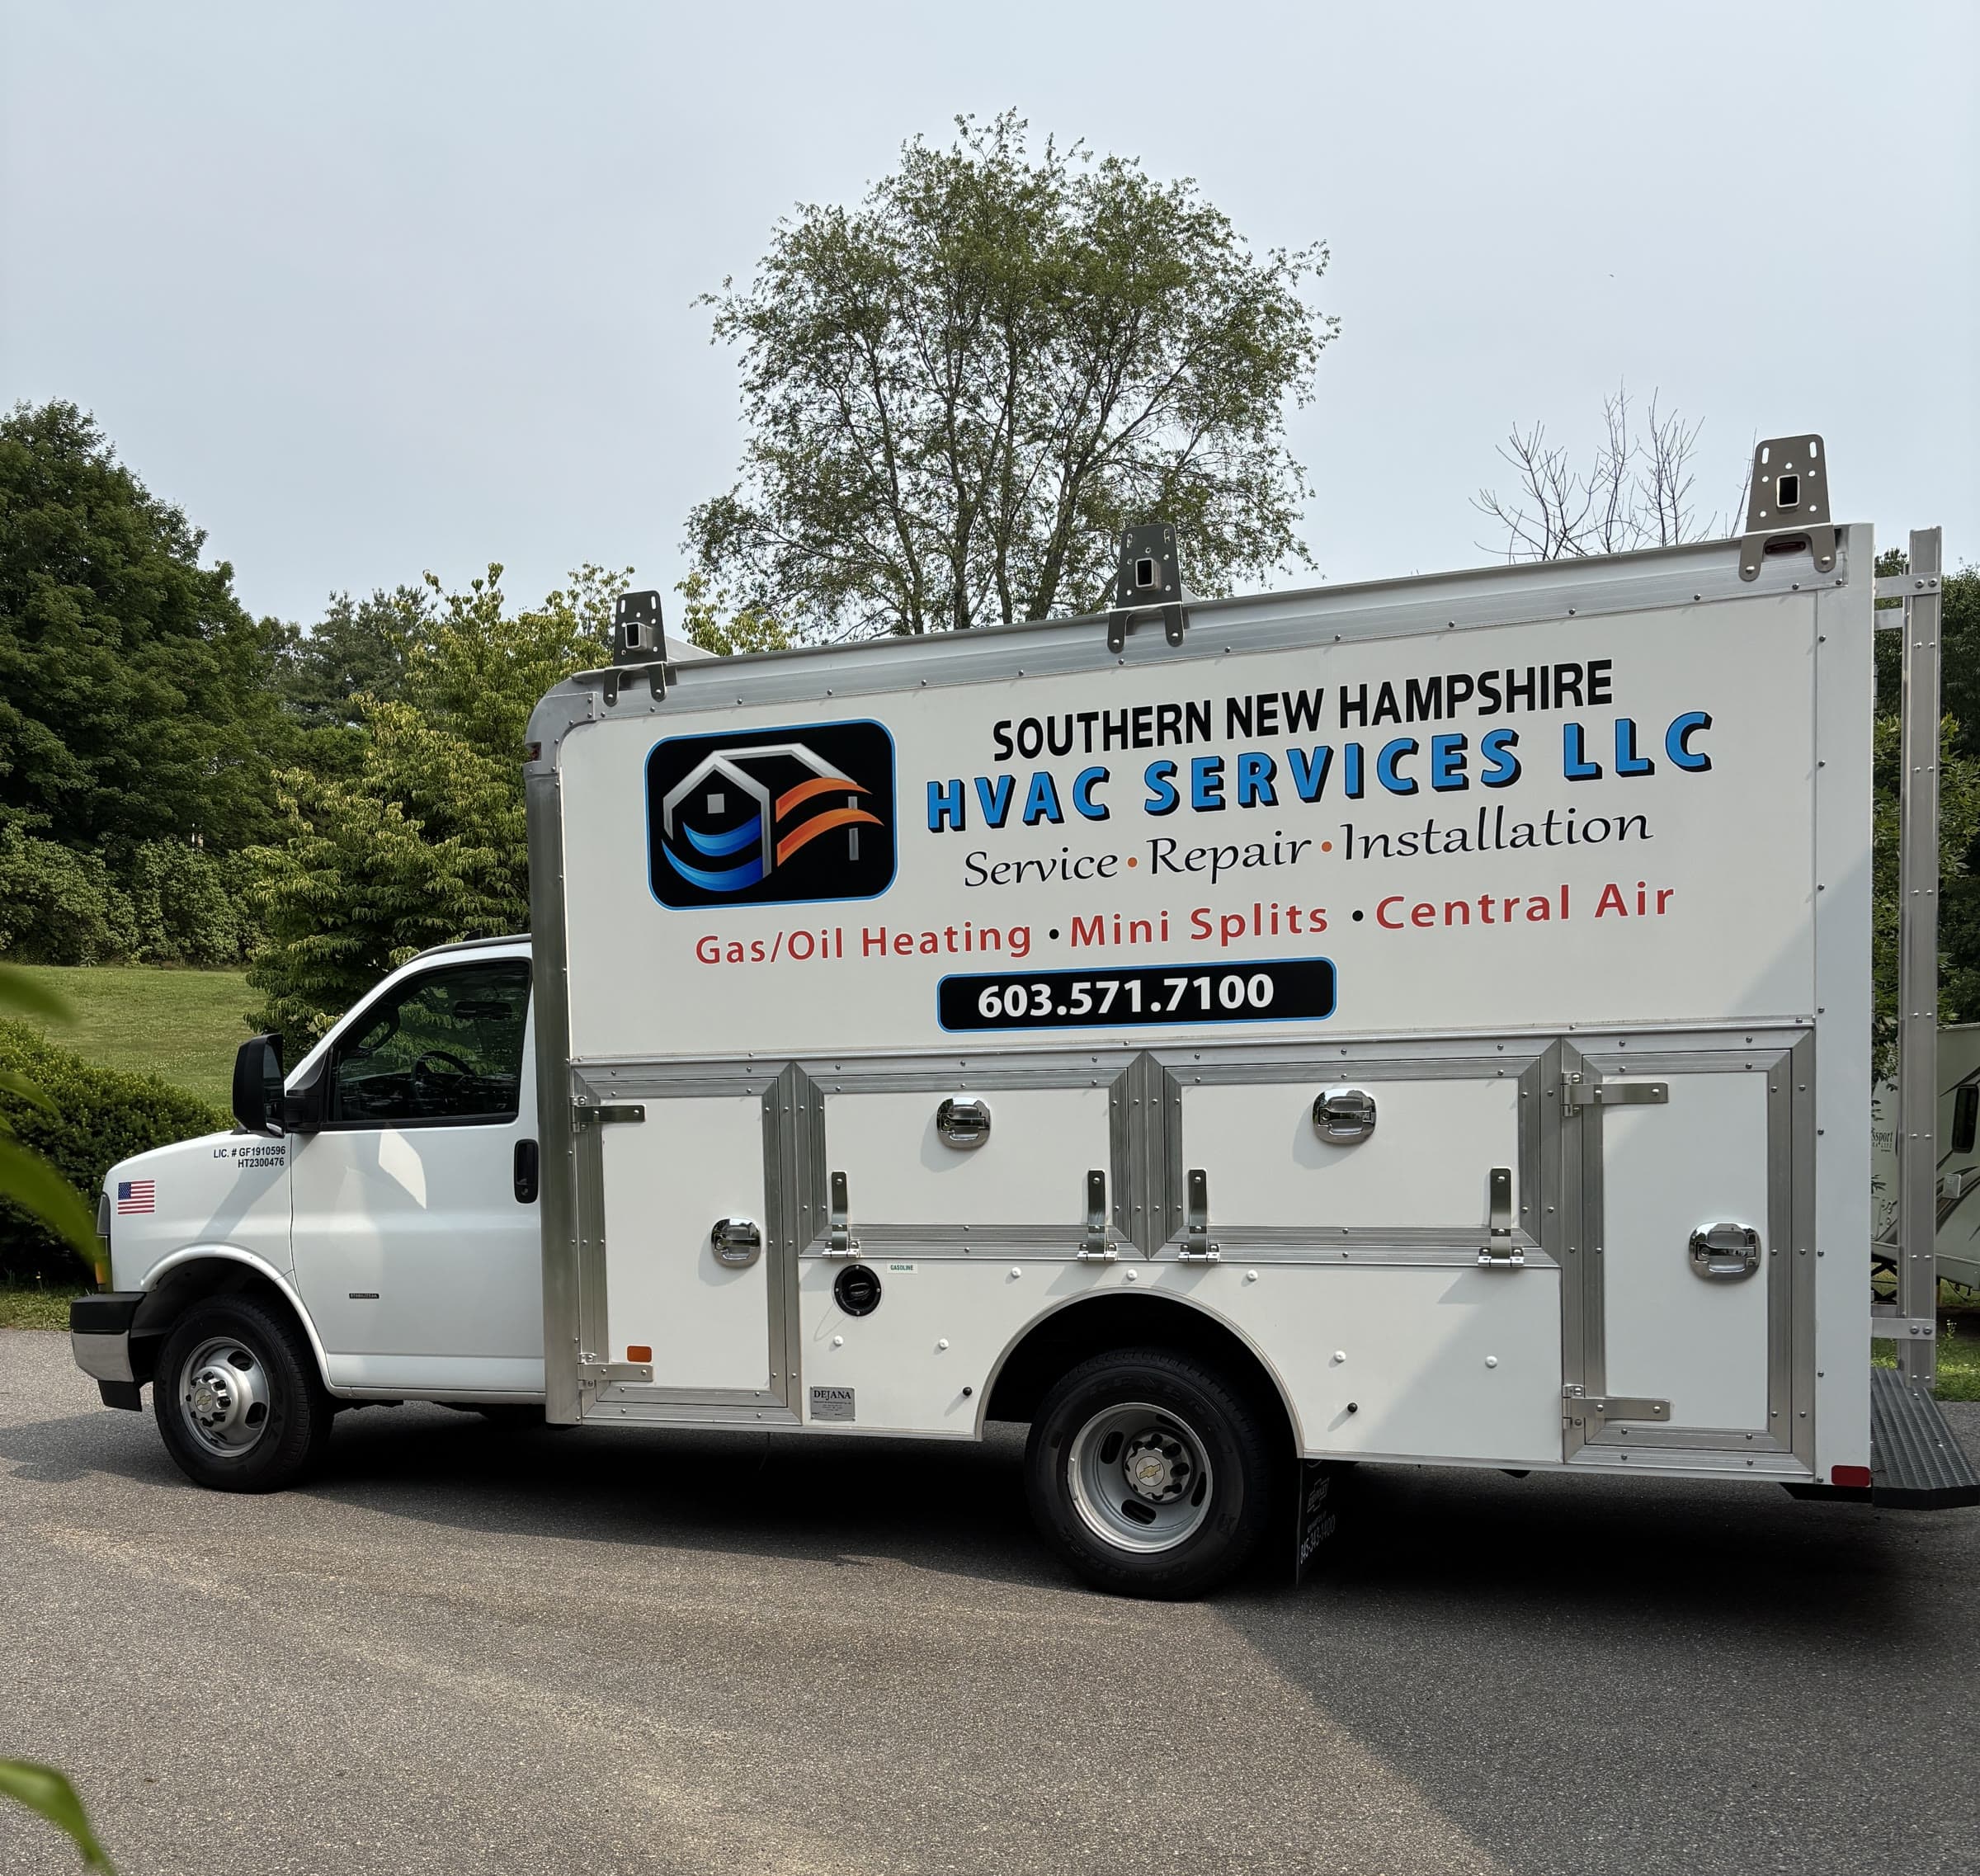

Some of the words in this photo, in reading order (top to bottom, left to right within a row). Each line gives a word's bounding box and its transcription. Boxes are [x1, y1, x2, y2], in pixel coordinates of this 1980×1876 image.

[993, 700, 1211, 761] SOUTHERN
[1227, 688, 1324, 739] NEW
[1340, 659, 1612, 728] HAMPSHIRE
[927, 766, 1110, 833] HVAC
[1144, 728, 1521, 816] SERVICES
[1563, 712, 1713, 781] LLC
[965, 847, 1117, 886] Service
[1147, 831, 1312, 884] Repair
[1340, 805, 1653, 860] Installation
[696, 928, 842, 964] Gas/Oil
[863, 922, 1030, 957] Heating
[1072, 911, 1167, 946] Mini
[1191, 903, 1327, 946] Splits
[1377, 884, 1568, 929] Central
[1595, 882, 1673, 917] Air
[978, 974, 1273, 1017] 603.571.7100
[214, 1149, 229, 1157] LIC.
[232, 1148, 237, 1157] #
[239, 1146, 285, 1157] GF1910596
[238, 1157, 285, 1167] HT2300476
[813, 1390, 851, 1400] DEJANA
